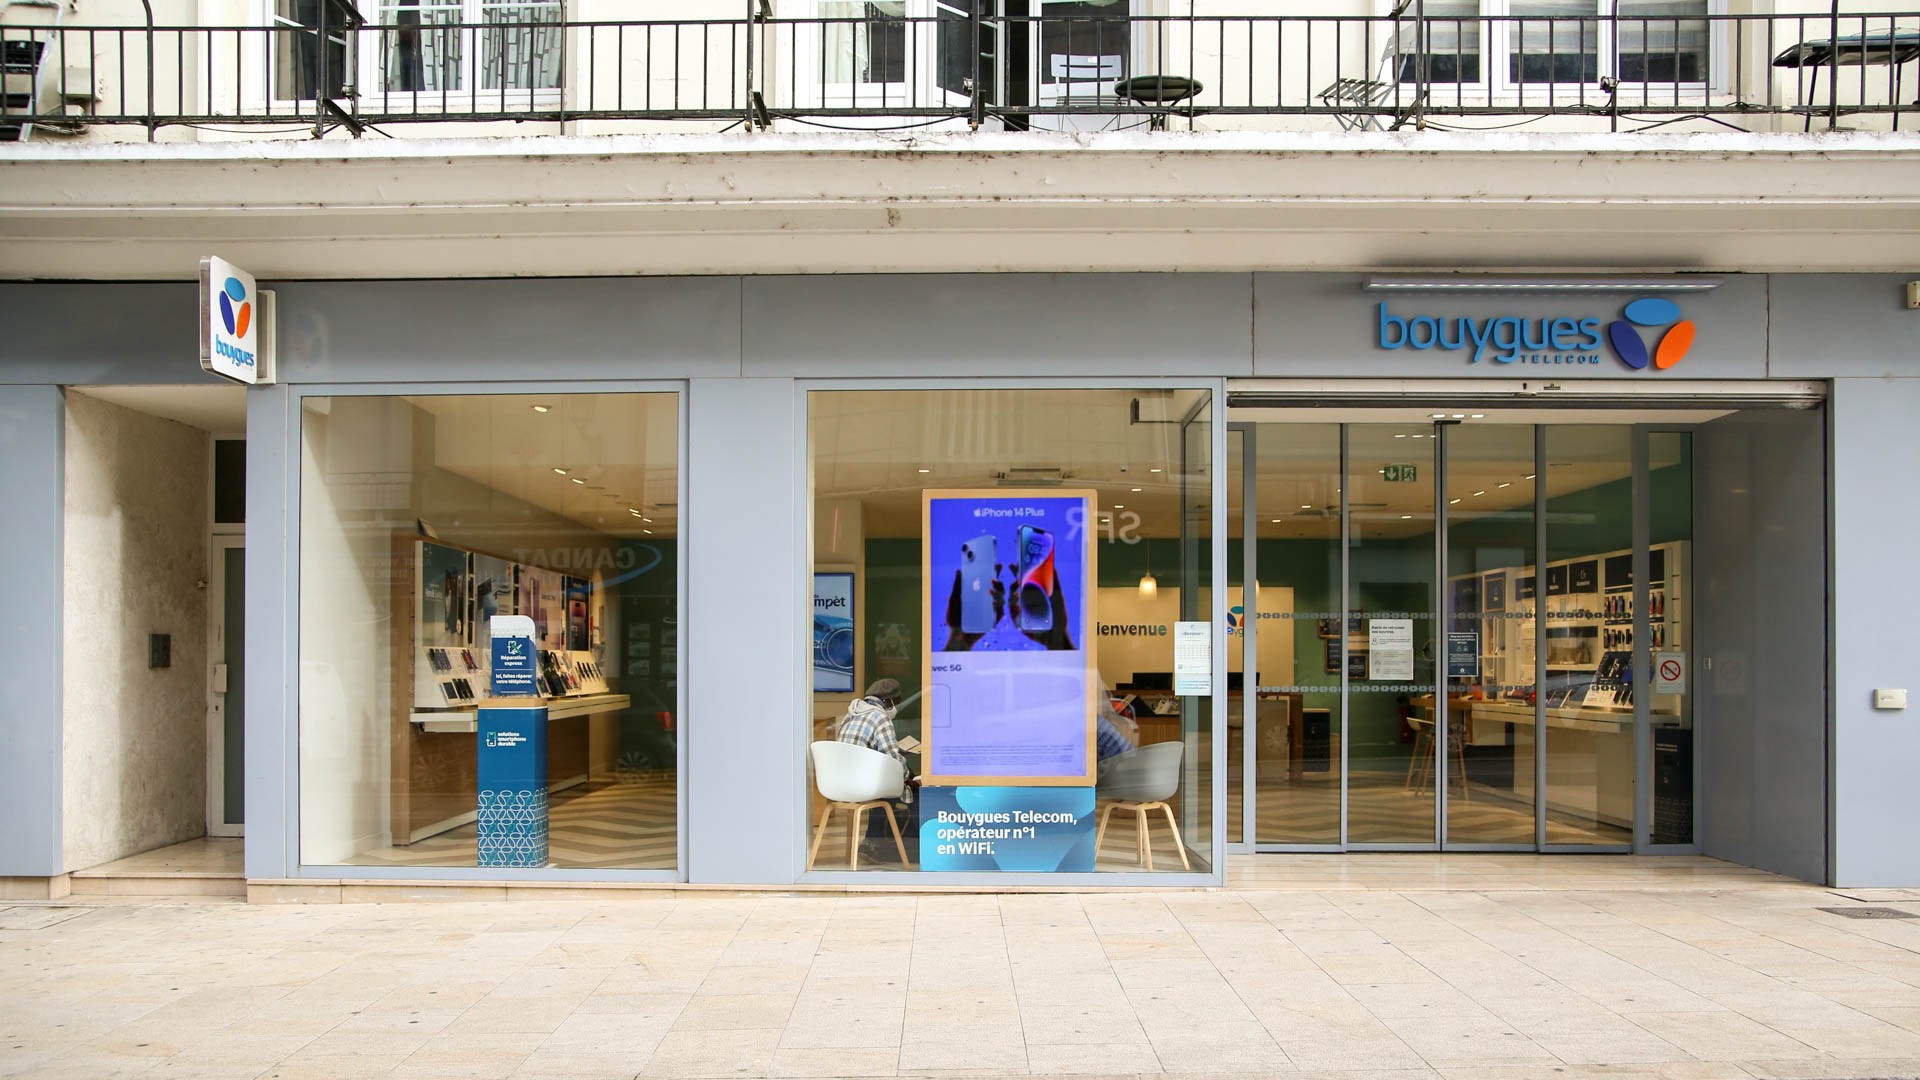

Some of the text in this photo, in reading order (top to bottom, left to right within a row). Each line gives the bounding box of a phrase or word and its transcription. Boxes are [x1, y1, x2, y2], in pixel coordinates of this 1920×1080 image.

[1379, 301, 1602, 364] bouygues
[215, 333, 255, 367] bouygues
[1520, 354, 1600, 364] TELECOM
[981, 507, 1045, 517] iPhone 14 Plus
[1097, 622, 1167, 637] ienvenue
[949, 664, 962, 672] 5G
[937, 810, 1078, 826] Bouygues Telecom,
[937, 826, 1011, 841] opérateur
[937, 844, 956, 855] en
